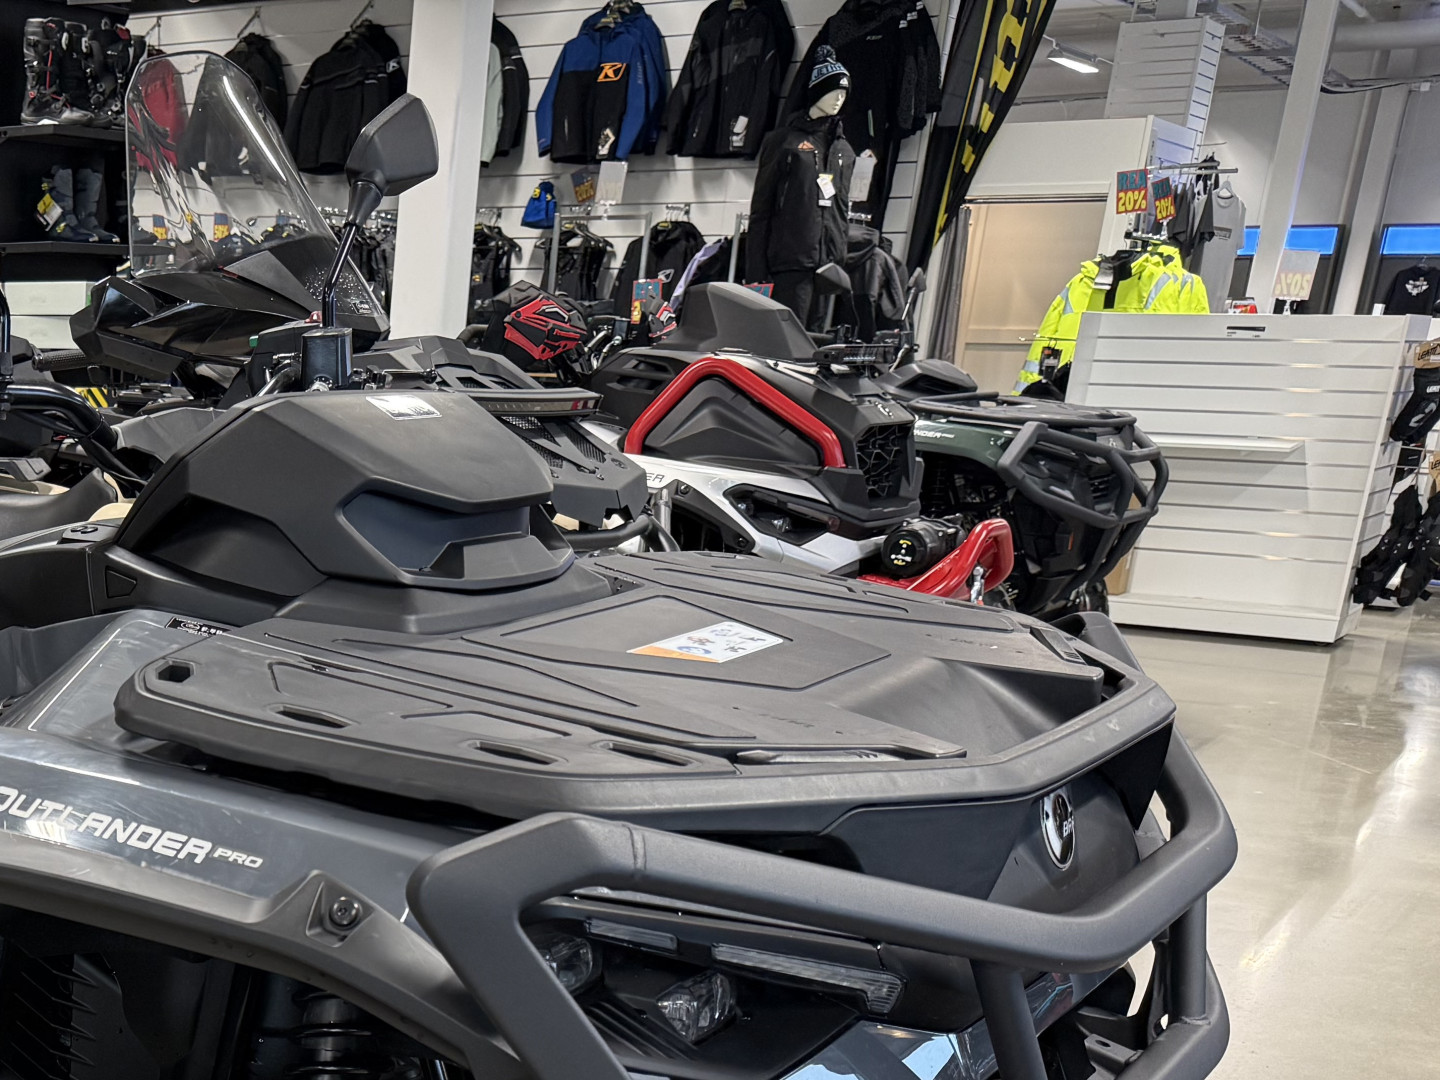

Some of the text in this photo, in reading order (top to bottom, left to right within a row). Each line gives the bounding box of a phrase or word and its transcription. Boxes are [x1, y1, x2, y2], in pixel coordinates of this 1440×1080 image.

[1118, 171, 1147, 191] REA
[1117, 190, 1147, 212] 20%
[1155, 196, 1175, 220] 20%
[213, 847, 264, 869] PRO
